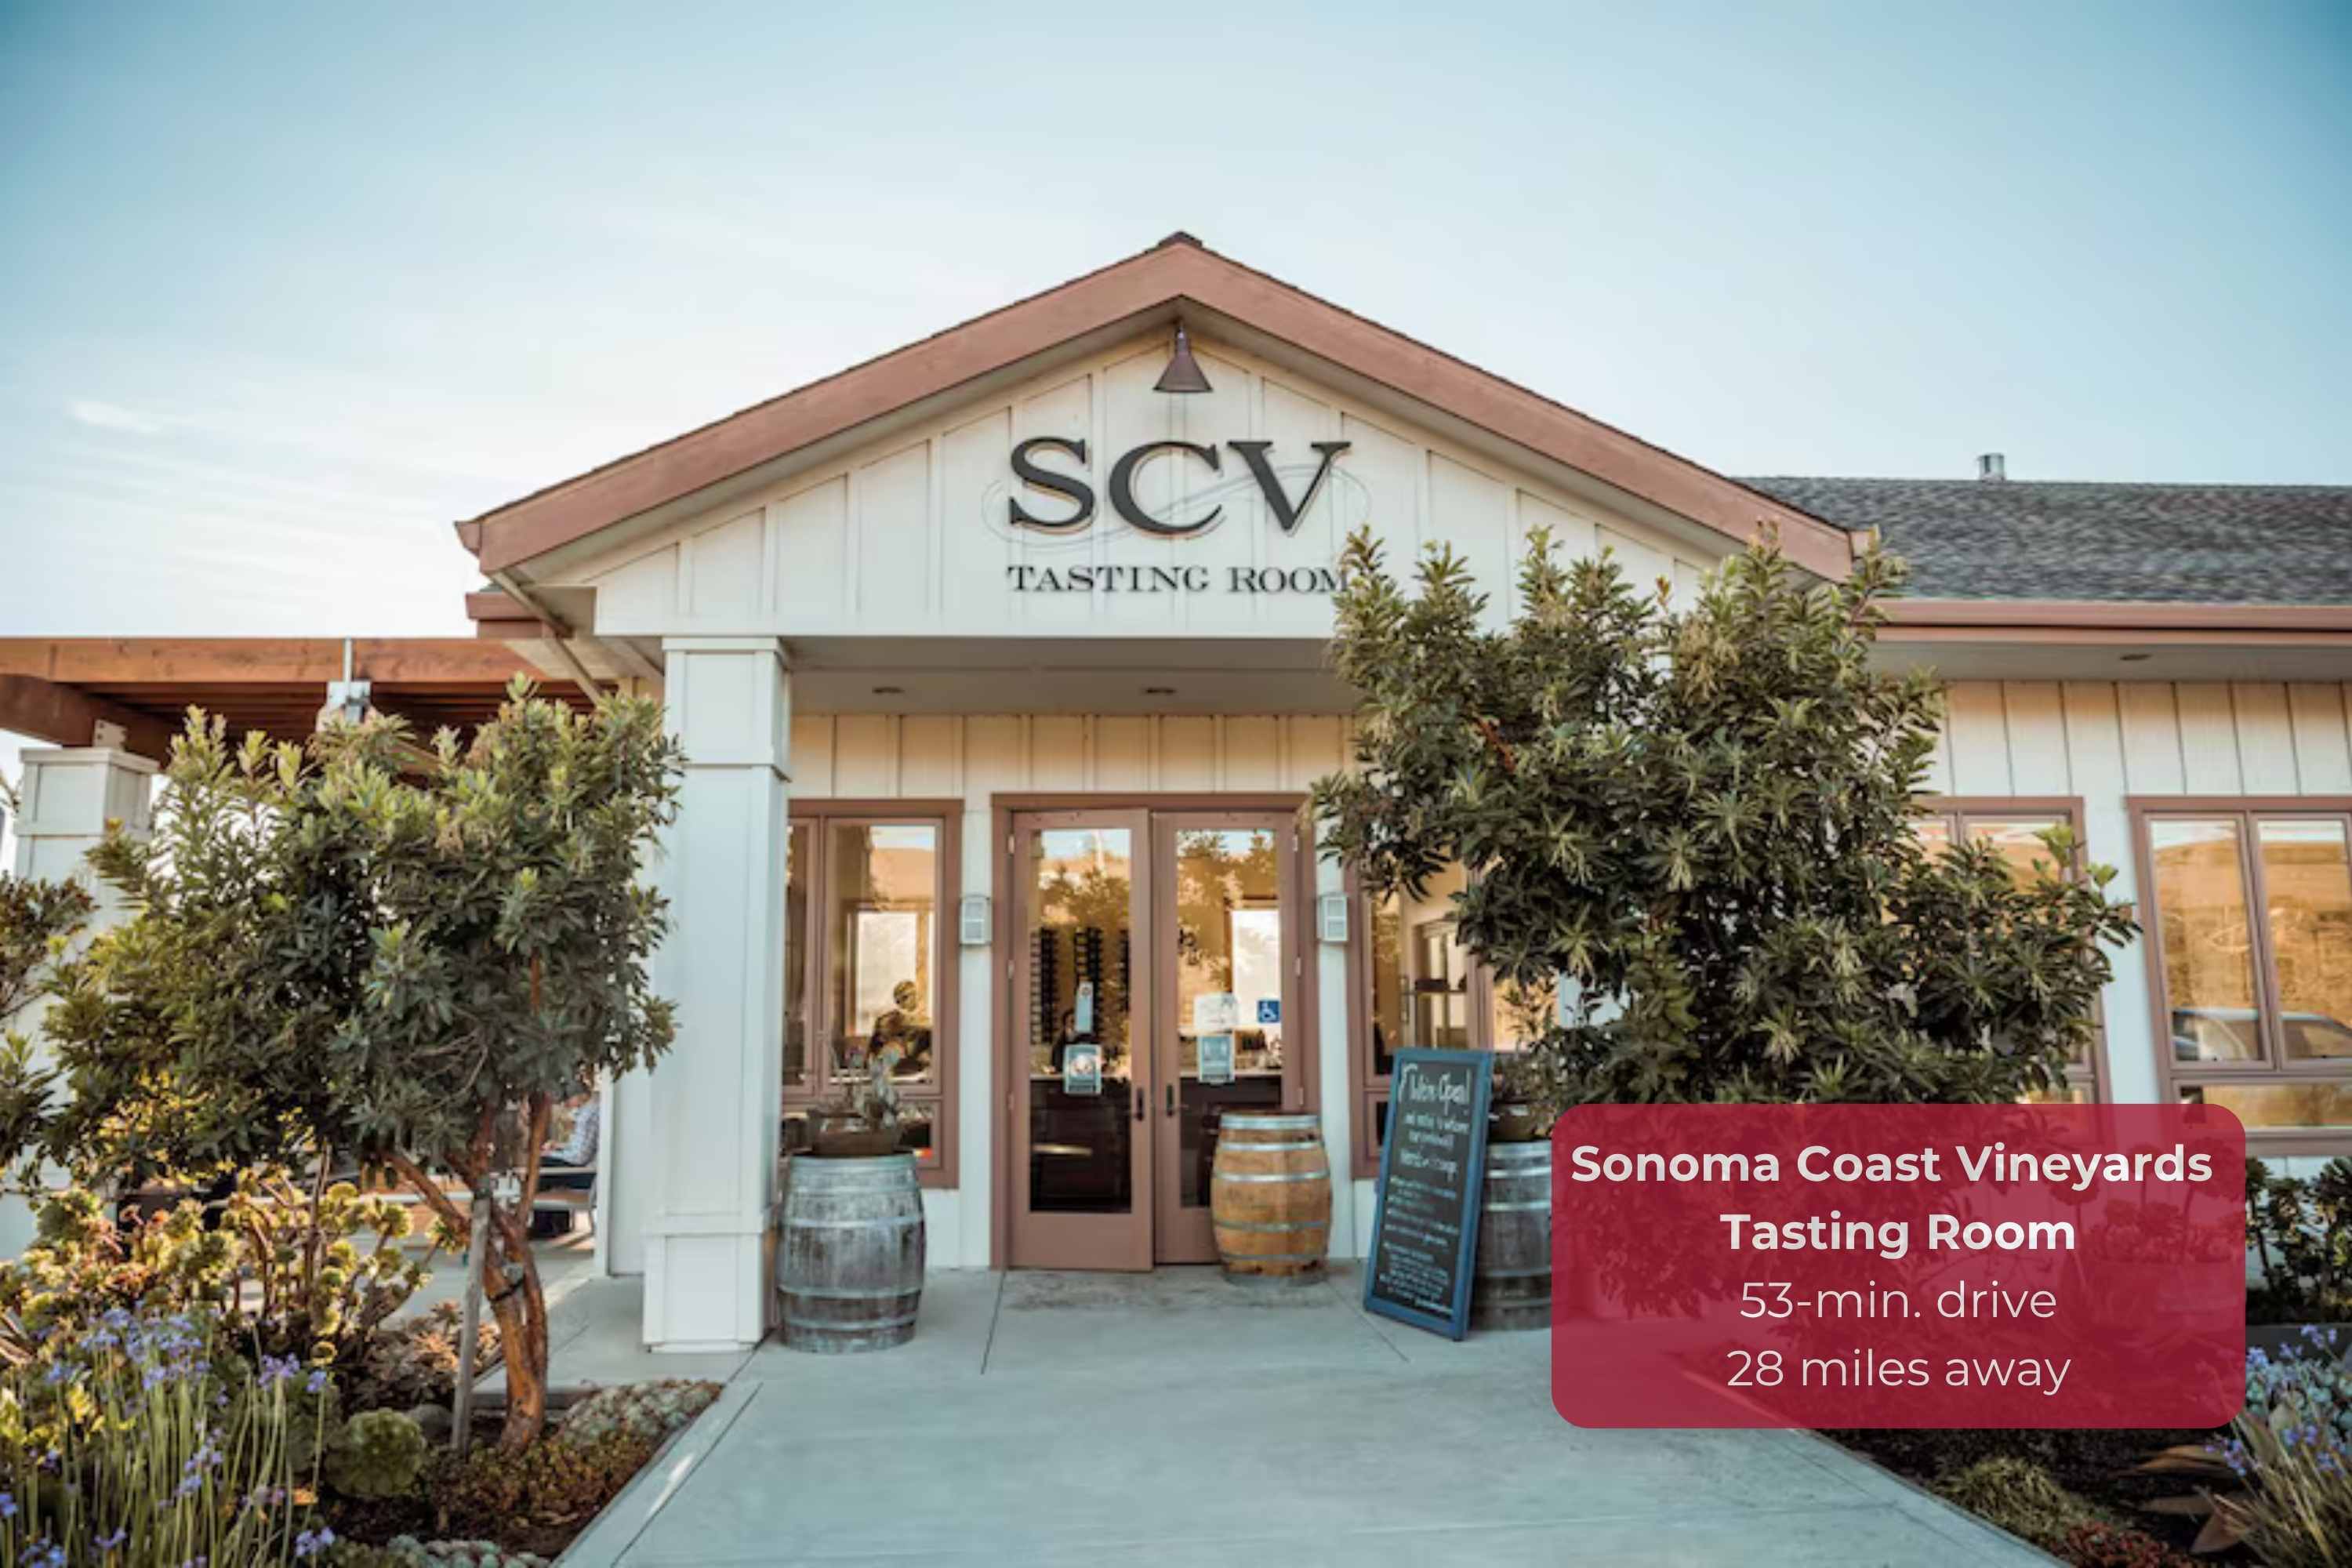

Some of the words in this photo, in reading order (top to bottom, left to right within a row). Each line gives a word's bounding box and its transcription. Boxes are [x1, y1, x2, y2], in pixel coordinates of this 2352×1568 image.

[1008, 435, 1353, 535] SCV
[1007, 565, 1210, 593] TASTING
[1226, 565, 1348, 593] ROOM
